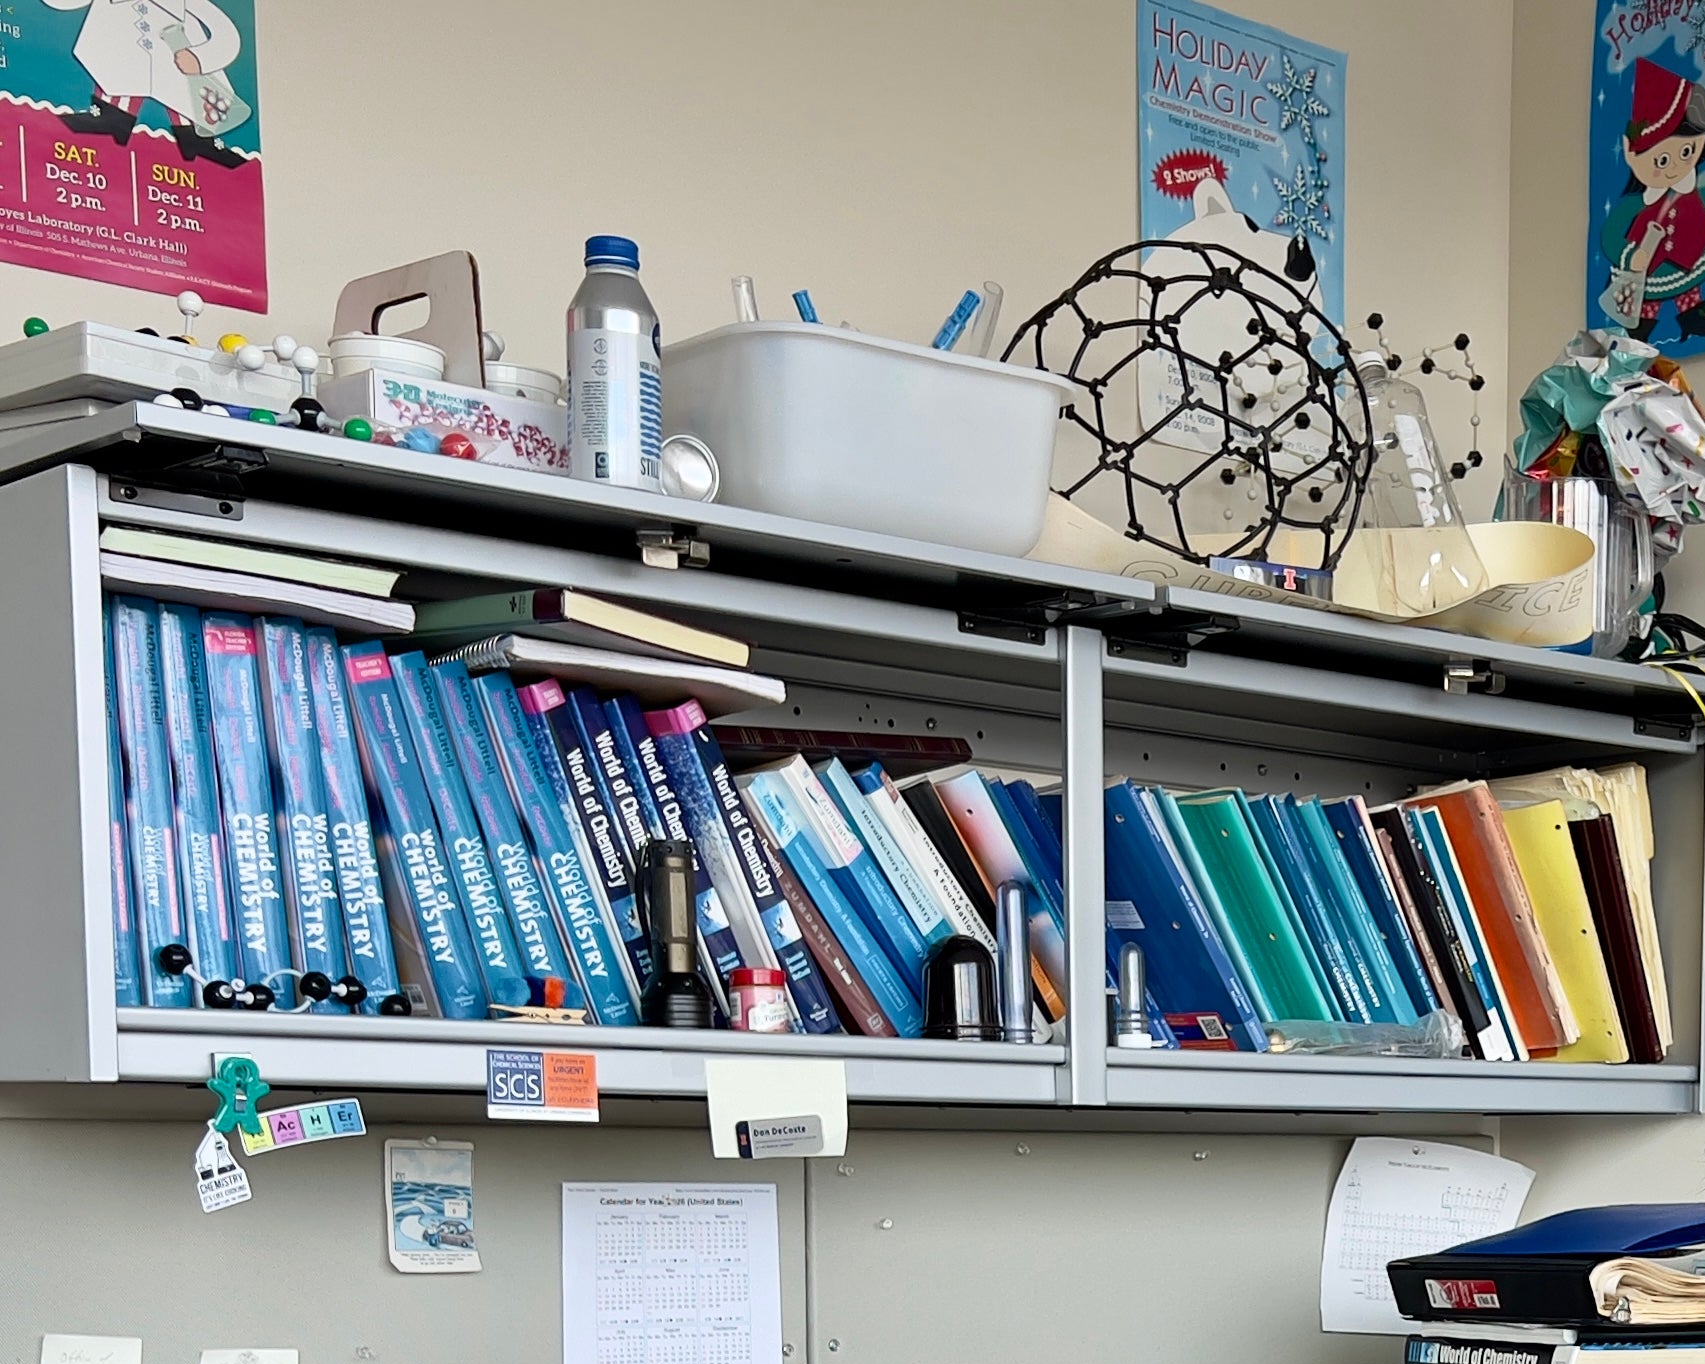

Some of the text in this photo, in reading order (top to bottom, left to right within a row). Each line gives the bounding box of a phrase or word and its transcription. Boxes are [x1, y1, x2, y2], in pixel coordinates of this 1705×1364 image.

[1153, 12, 1269, 83] HOLIDAY
[1150, 95, 1278, 144] Chemistry Demonstration Show
[1153, 56, 1270, 126] MAGIC
[45, 163, 107, 190] Dec. 10
[54, 141, 100, 168] SAT.
[152, 164, 200, 190] SUN.
[1163, 163, 1216, 186] 2 Shows!
[0, 208, 188, 256] oyes Laboratory (G.L. Clark Hall)
[56, 187, 106, 211] 2 p.m.
[147, 185, 204, 212] Dec. 11
[157, 209, 205, 233] 2 p.m.
[1474, 568, 1588, 618] ICE
[292, 632, 312, 729] McDougal Littell
[322, 643, 348, 738] McDougal Littell
[417, 667, 456, 768] McDougal Littell
[457, 676, 497, 776] McDougal Littell
[504, 688, 547, 787] McDougal Littell
[595, 730, 648, 852] World of Chemis
[638, 736, 671, 806] World of
[254, 813, 280, 900] World of
[312, 814, 338, 900] World of
[566, 747, 628, 889] World of Chemistry
[712, 763, 775, 899] World of Chemistry
[143, 826, 160, 907] CHEMISTRY
[191, 832, 208, 913] CHEMISTRY
[233, 812, 267, 953] CHEMISTRY
[292, 814, 328, 953] CHEMISTRY
[333, 821, 375, 959] CHEMISTRY
[353, 821, 383, 905] World of
[401, 832, 455, 964] CHEMISTRY
[419, 828, 456, 912] World of
[454, 837, 507, 968] CHEMISTRY
[861, 809, 932, 924] Introductory Chemistry
[923, 836, 998, 955] Introductory Chemistry
[497, 844, 552, 972] CHEMISTRY
[550, 851, 609, 978] CHEMISTRY
[939, 878, 976, 938] Foundation
[494, 1053, 505, 1061] THE
[506, 1054, 530, 1062] SCHOOL
[494, 1072, 540, 1099] SCS
[553, 1065, 584, 1076] URGENT
[277, 1110, 354, 1133] Ac H Er
[753, 1125, 806, 1138] Don DeCoste
[199, 1173, 245, 1195] CHEMISTRY
